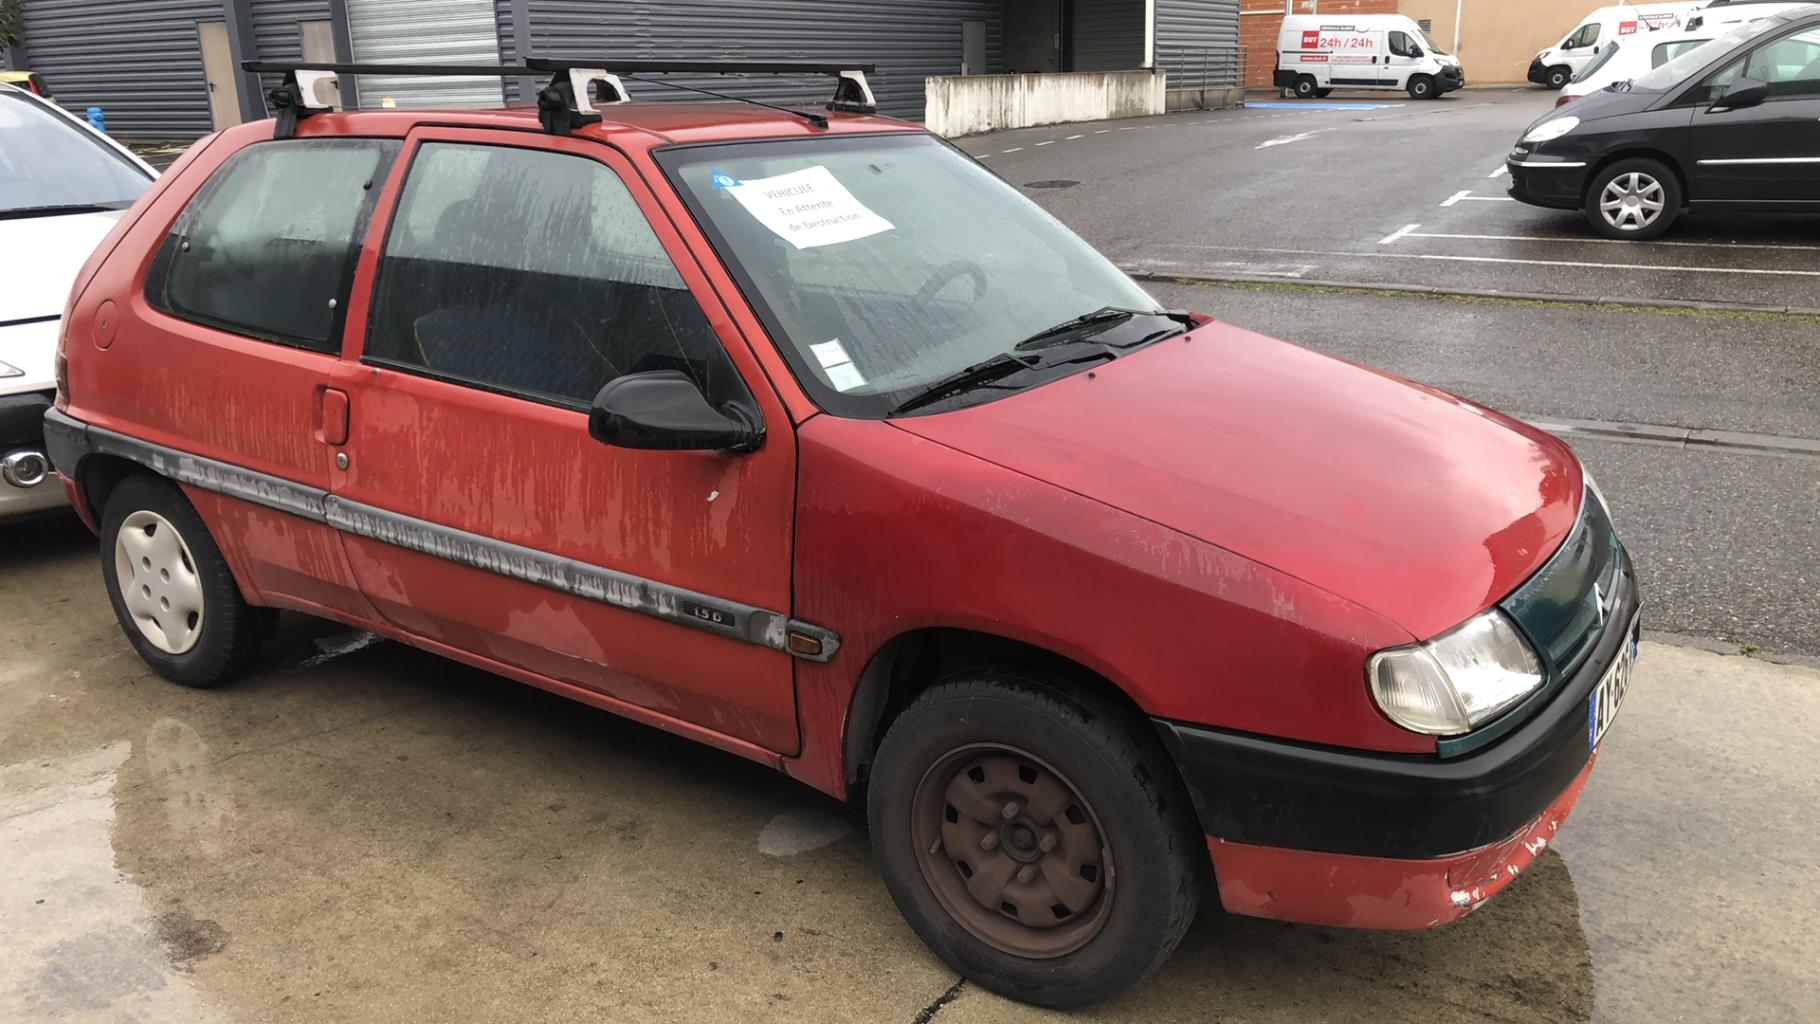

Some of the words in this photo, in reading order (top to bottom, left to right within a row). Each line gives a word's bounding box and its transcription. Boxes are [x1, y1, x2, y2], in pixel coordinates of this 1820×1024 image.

[1320, 38, 1341, 48] 24h
[1351, 38, 1373, 48] 24h
[778, 206, 795, 216] En
[796, 200, 834, 213] Attente
[788, 222, 802, 232] de
